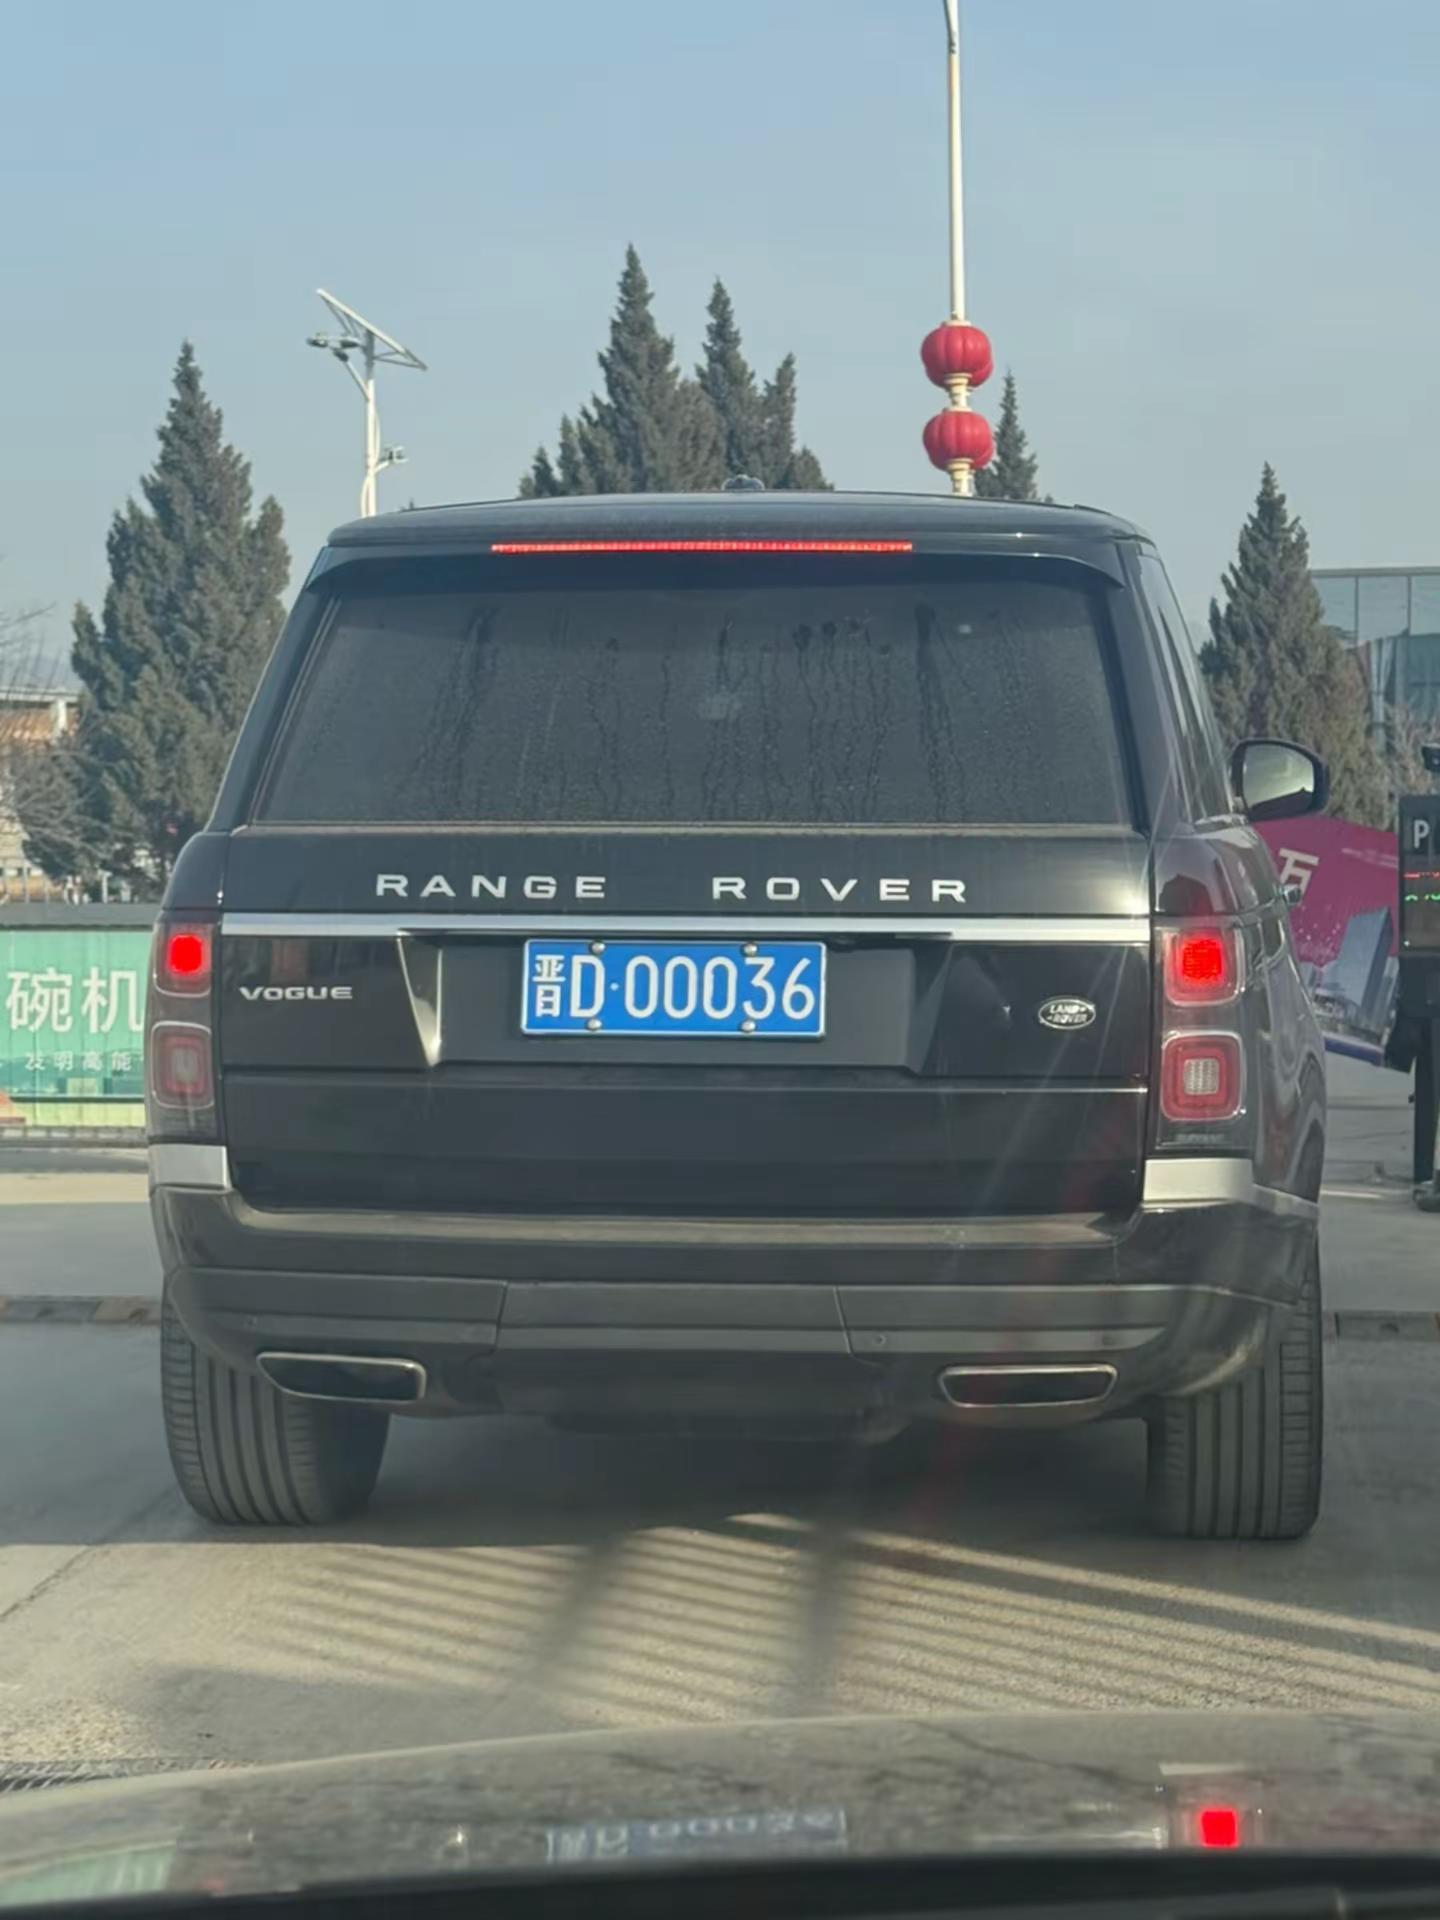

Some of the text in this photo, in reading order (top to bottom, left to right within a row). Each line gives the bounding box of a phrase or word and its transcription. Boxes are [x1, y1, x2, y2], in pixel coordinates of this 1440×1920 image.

[375, 873, 967, 903] RANGE ROVER
[5, 966, 144, 1034] 碗机
[239, 986, 353, 1000] VOGUE
